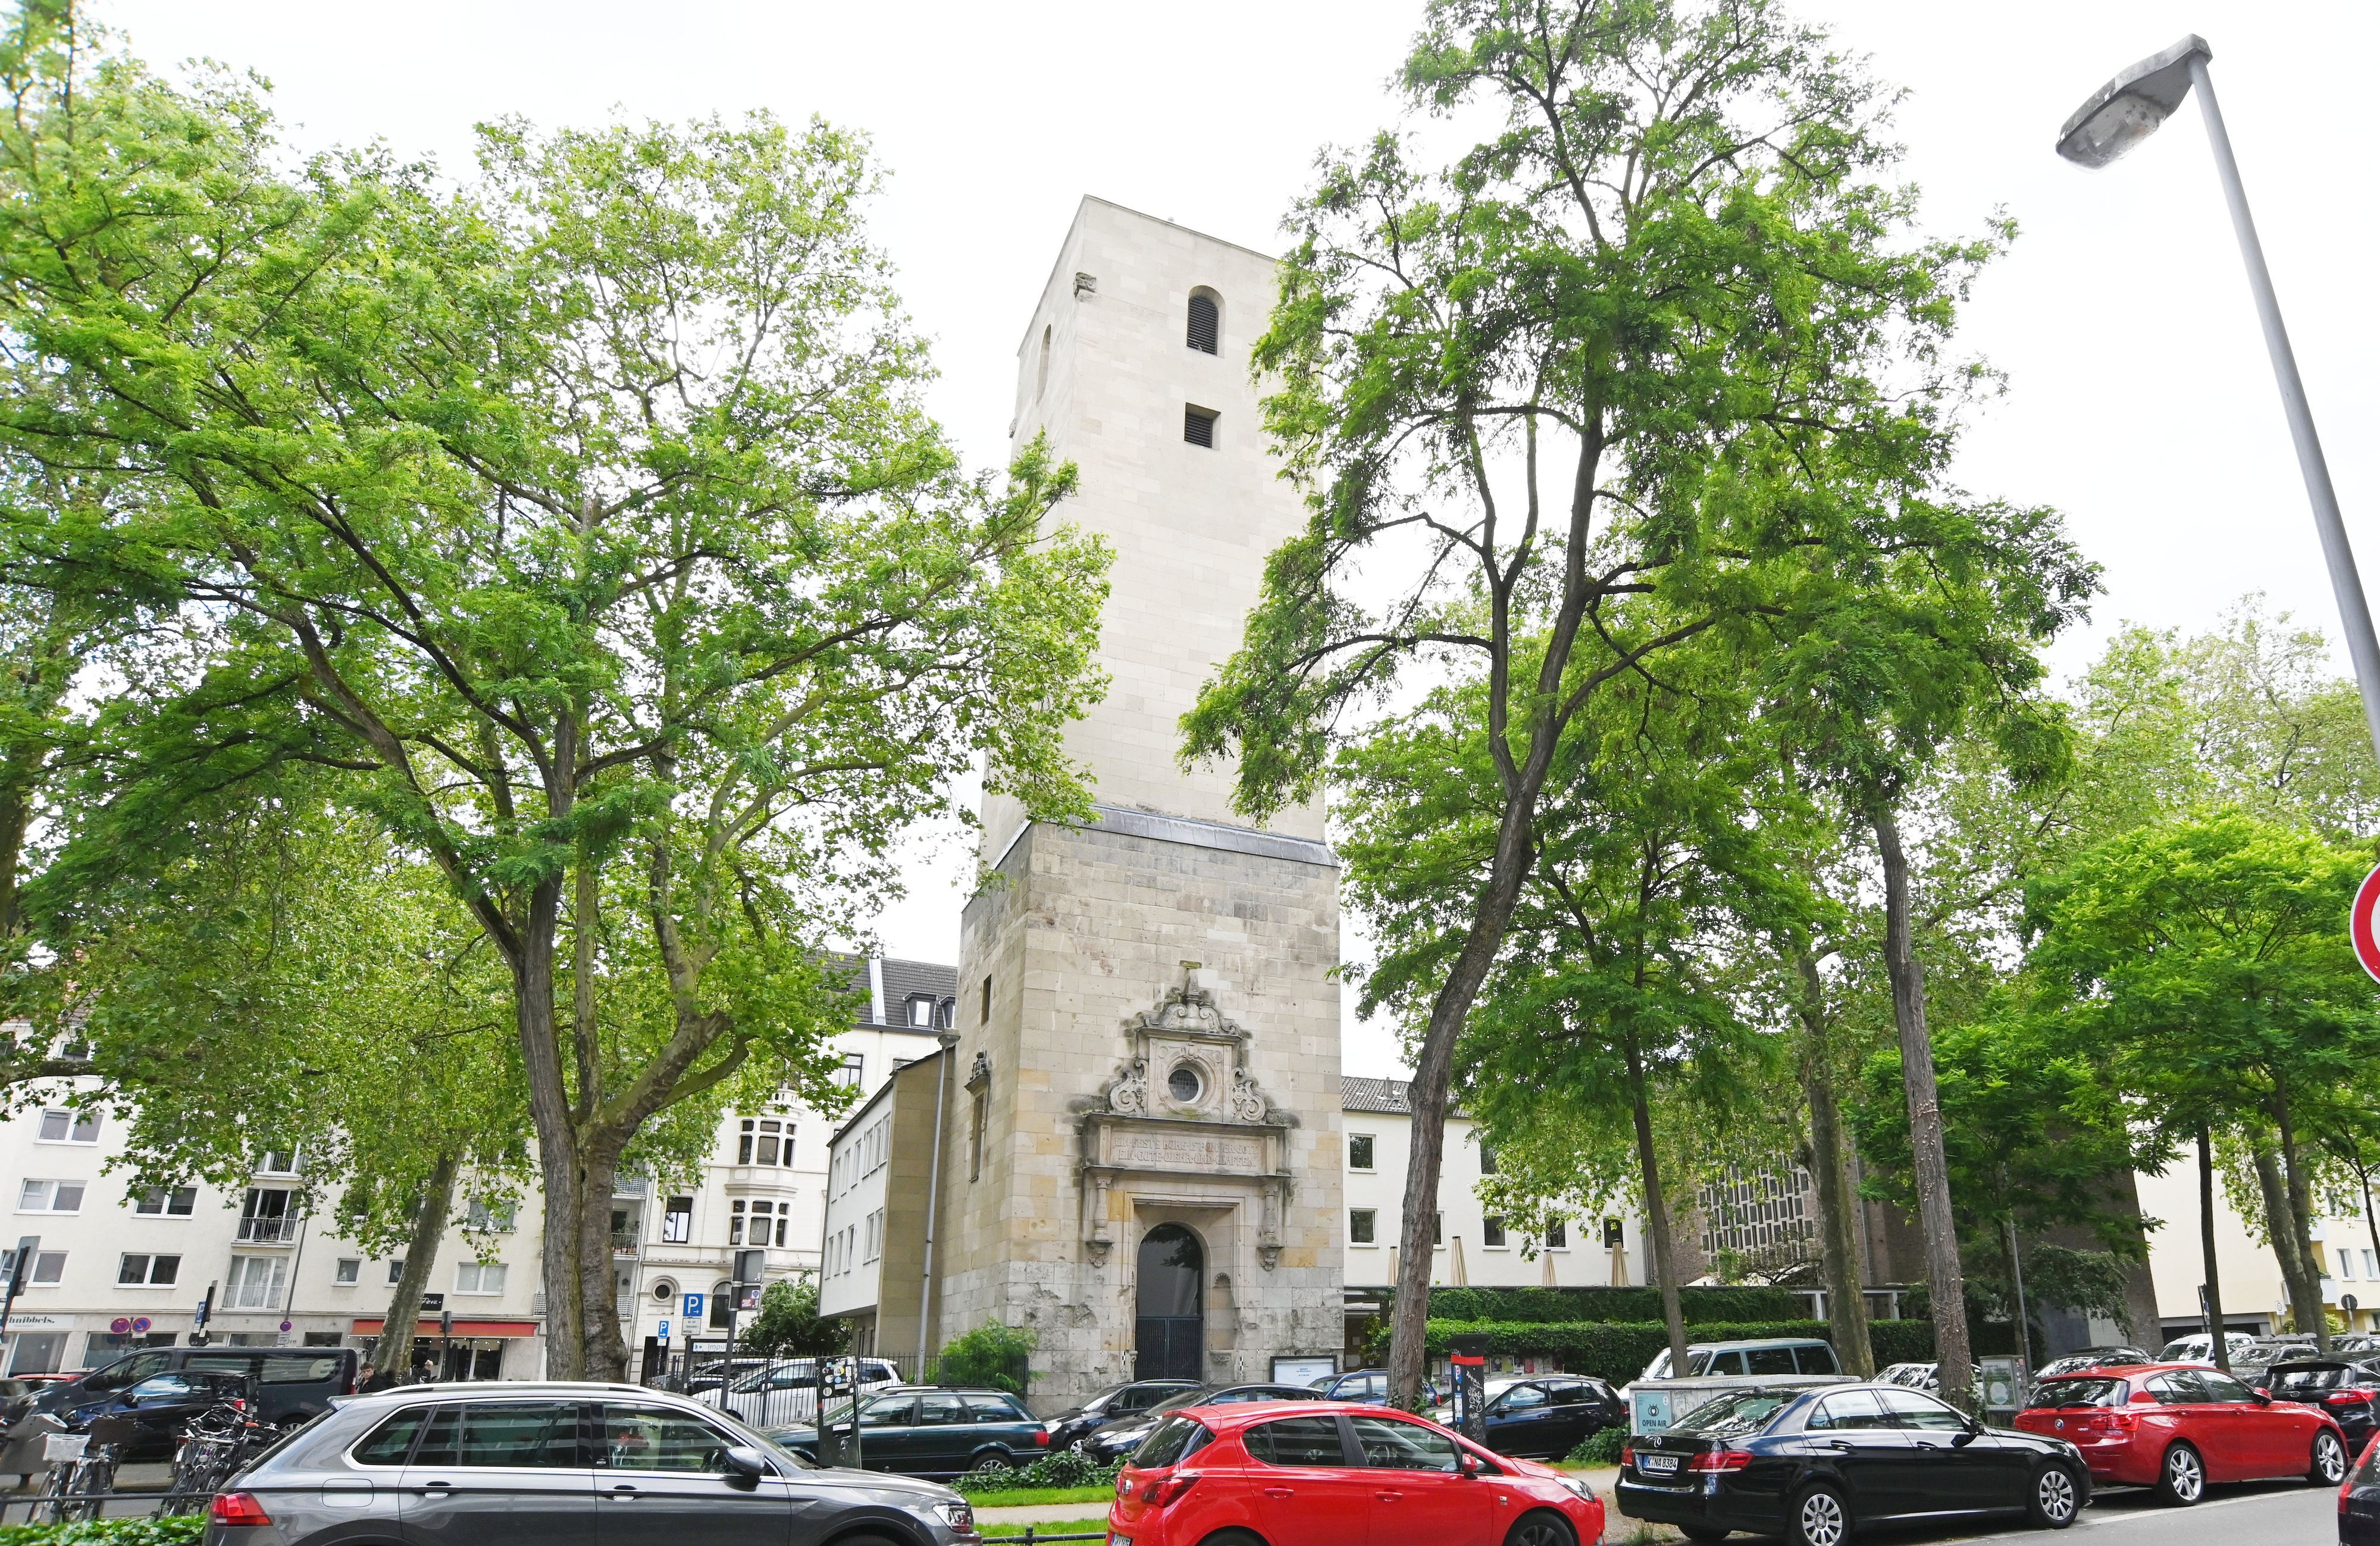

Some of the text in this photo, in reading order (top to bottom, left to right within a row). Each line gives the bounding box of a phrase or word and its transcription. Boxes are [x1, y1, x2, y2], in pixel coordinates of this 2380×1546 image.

[688, 1296, 699, 1314] P
[660, 1322, 667, 1332] P
[1647, 1457, 1677, 1469] K NA 8384
